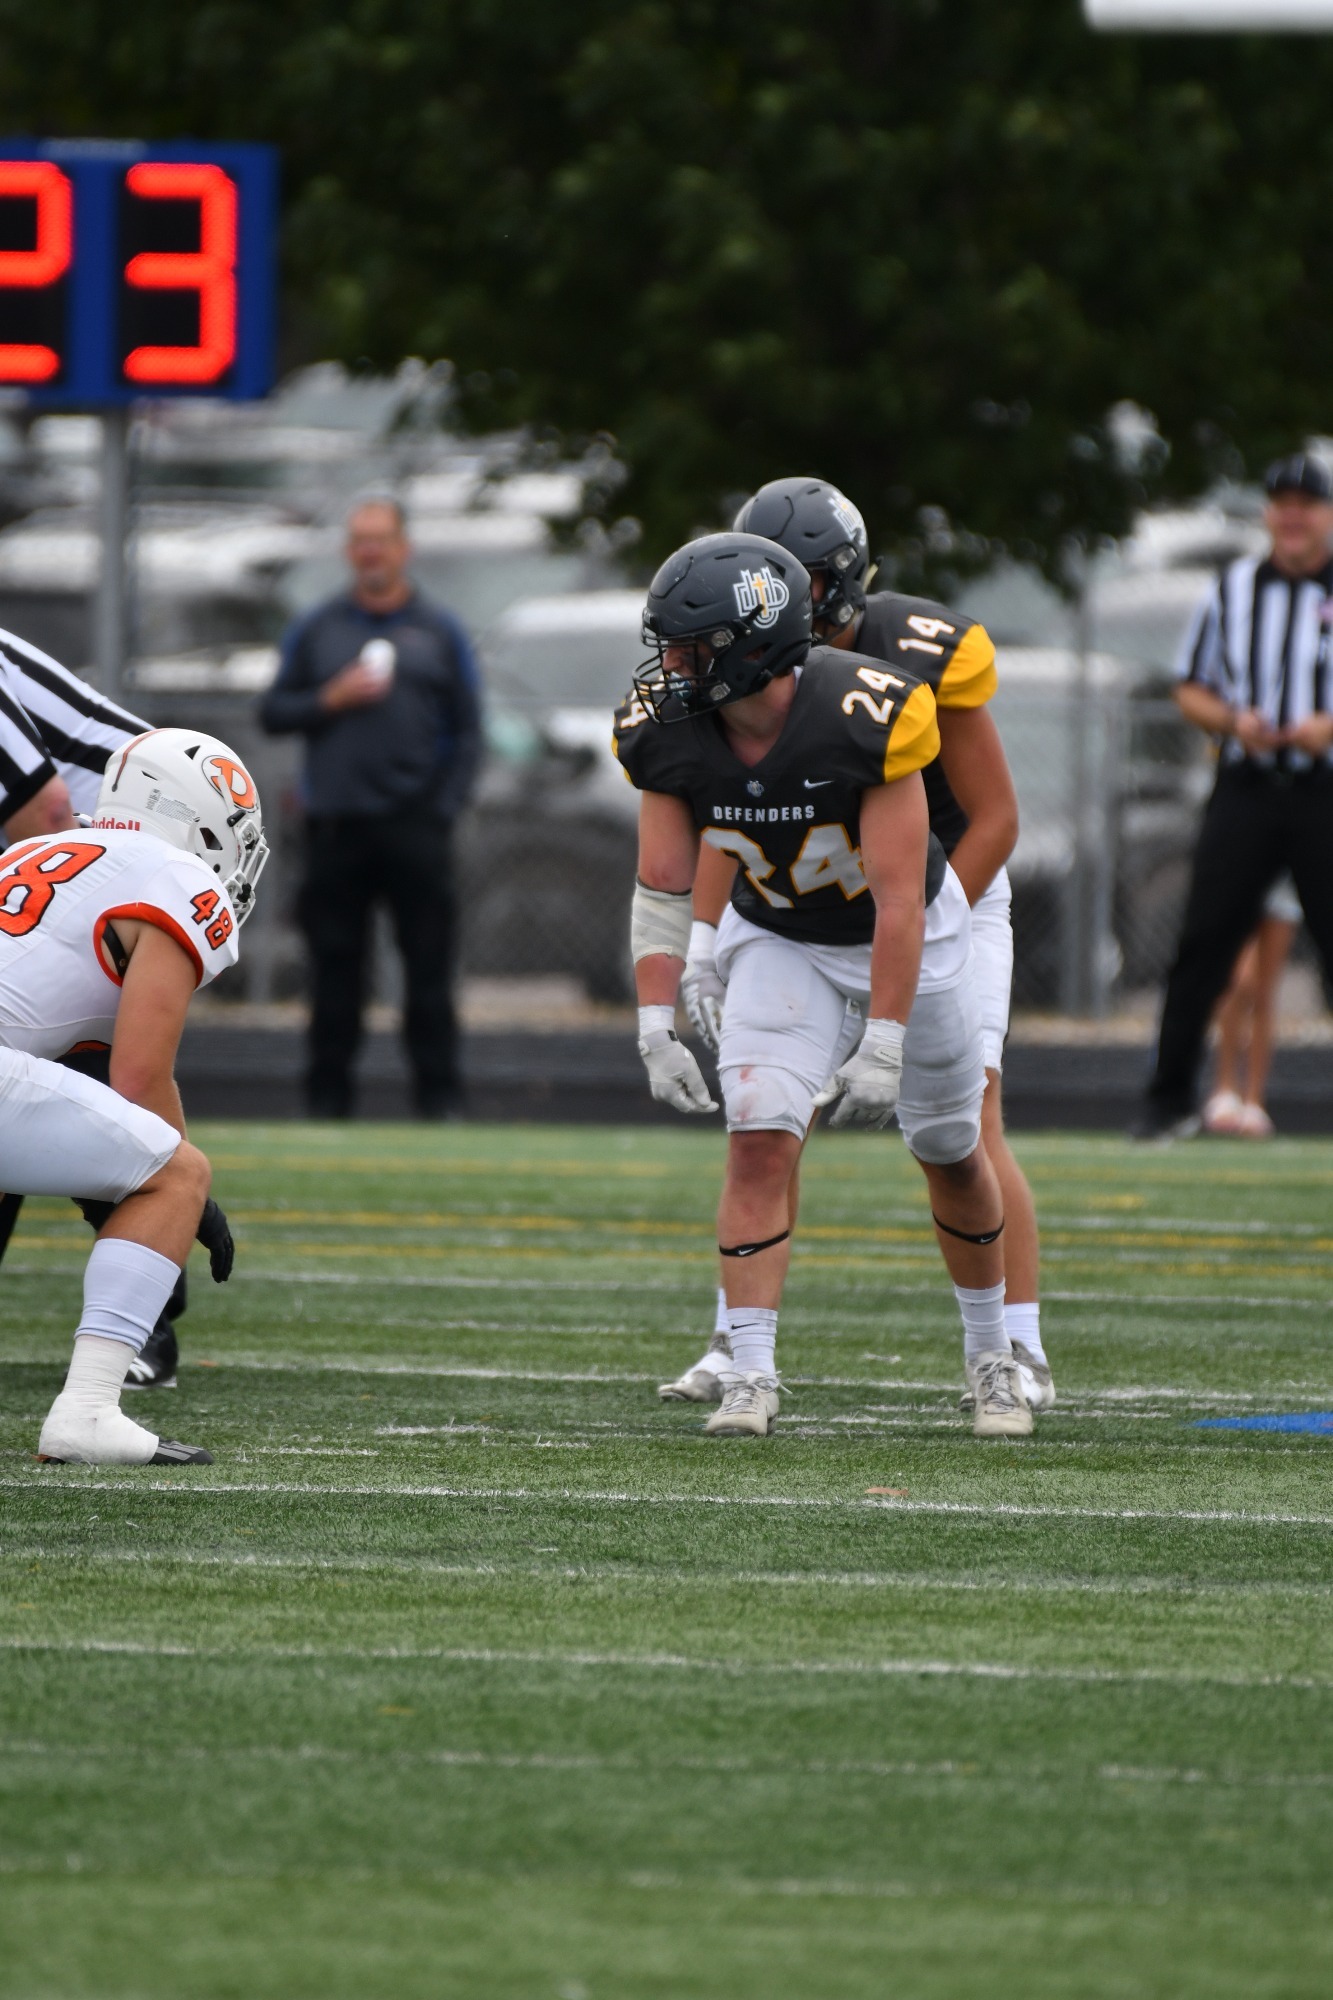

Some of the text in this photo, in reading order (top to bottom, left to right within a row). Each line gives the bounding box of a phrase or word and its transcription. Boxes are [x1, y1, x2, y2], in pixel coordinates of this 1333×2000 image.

[0, 161, 239, 383] 23
[899, 615, 956, 656] 14
[841, 666, 906, 724] 24
[713, 805, 815, 822] DEFENDERS
[189, 888, 233, 950] 48
